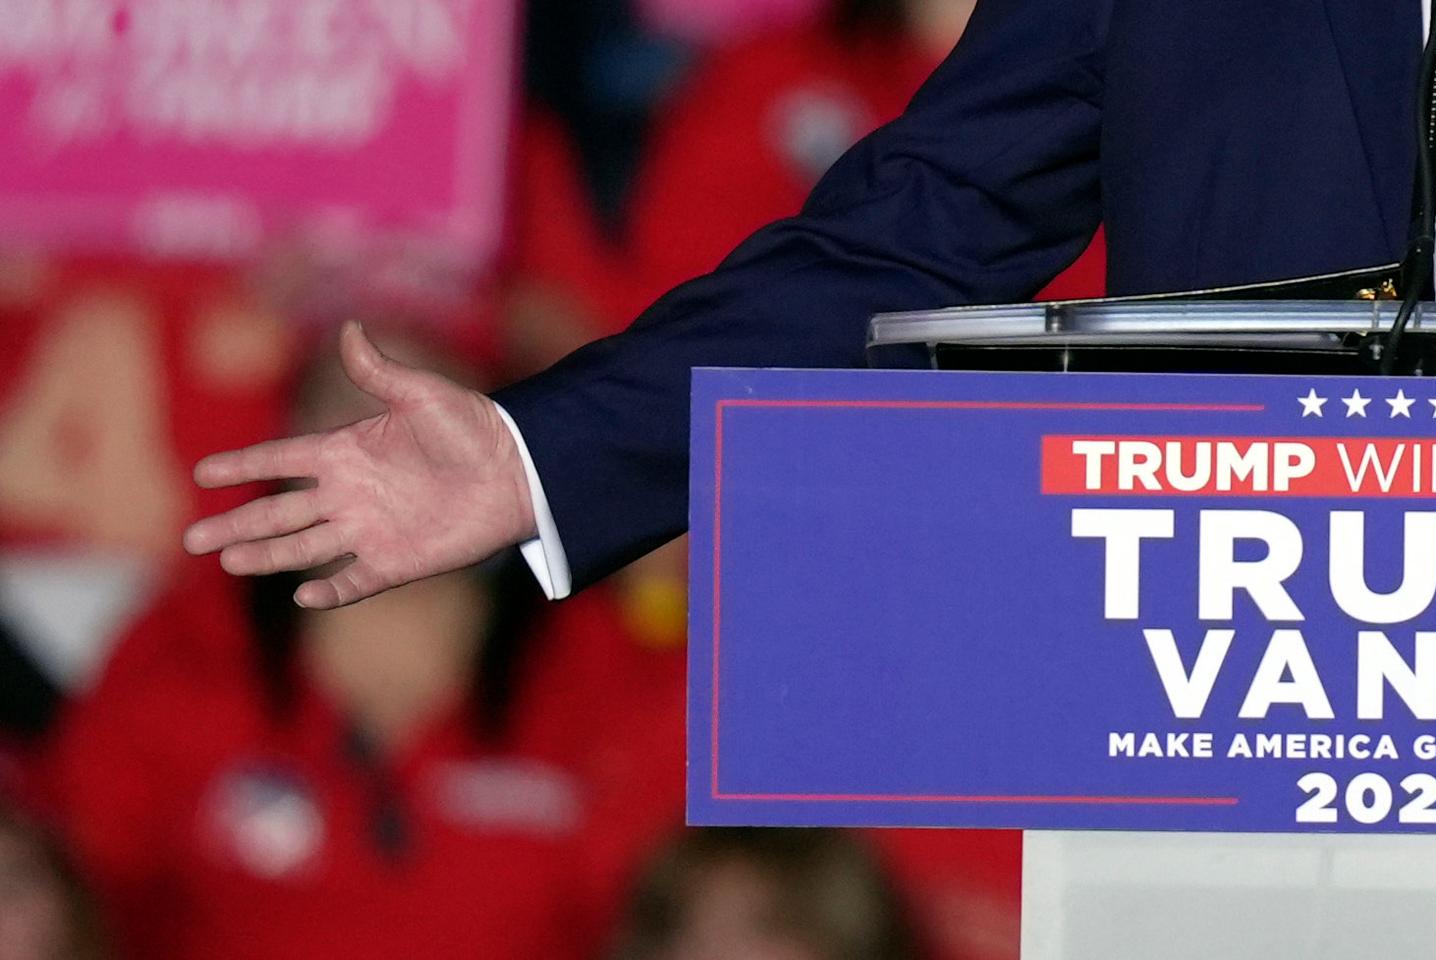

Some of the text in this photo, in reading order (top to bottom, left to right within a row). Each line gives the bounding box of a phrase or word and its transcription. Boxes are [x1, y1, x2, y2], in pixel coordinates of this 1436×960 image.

[1072, 440, 1316, 492] TRUMP
[1109, 732, 1213, 758] MAKE
[1227, 733, 1399, 759] AMERICA
